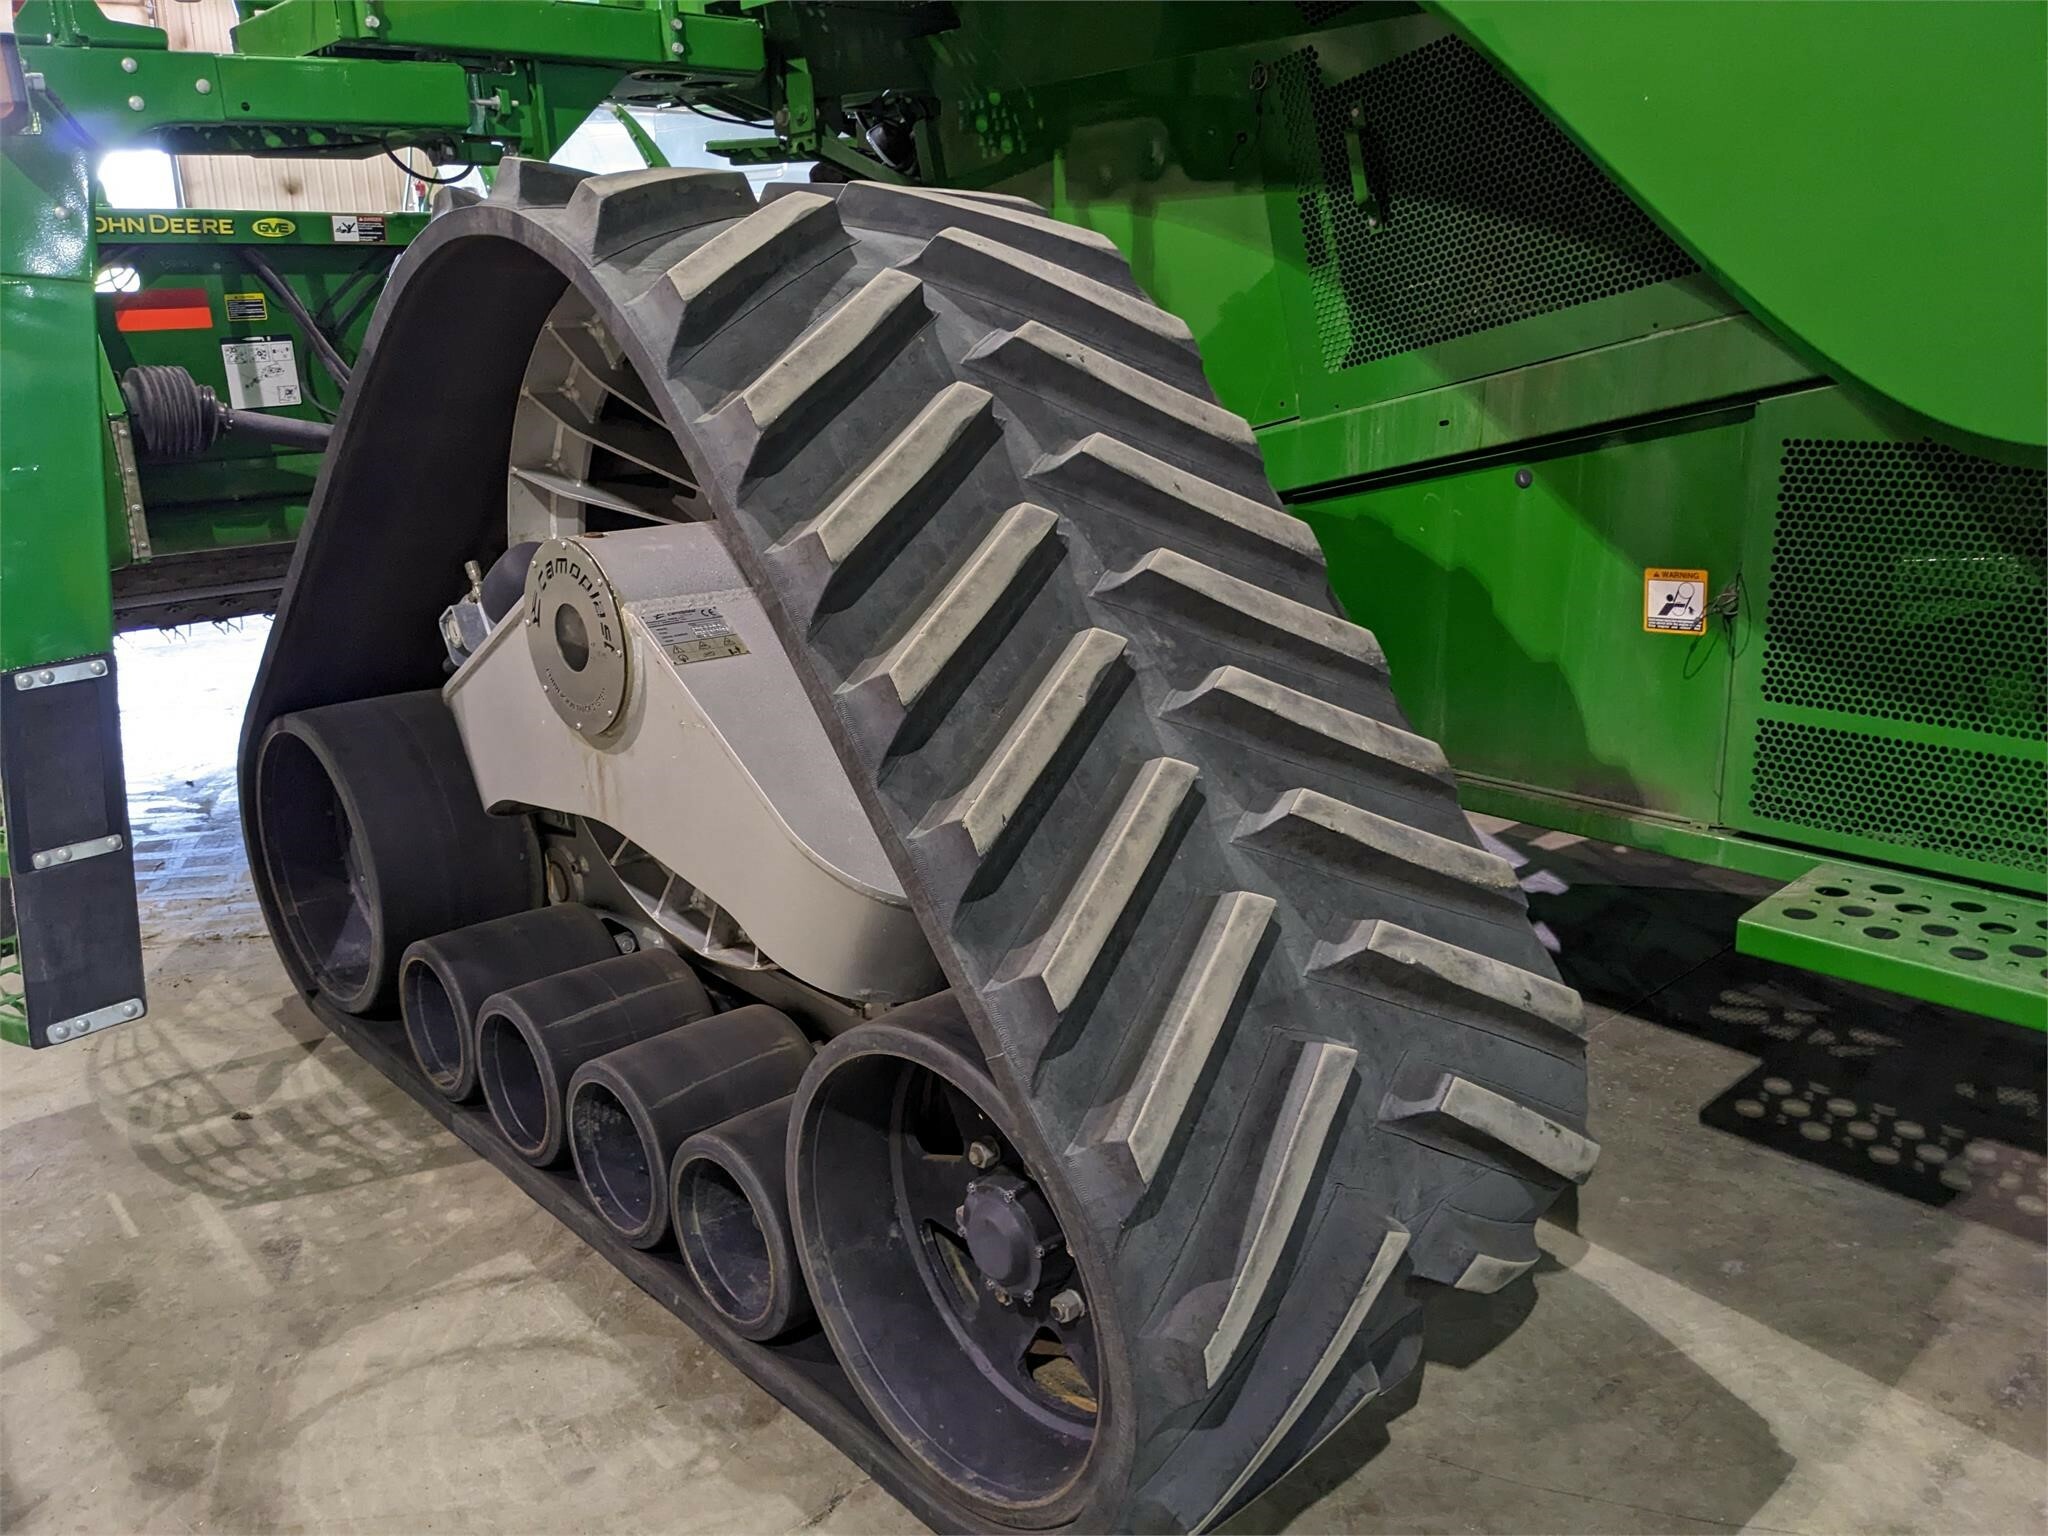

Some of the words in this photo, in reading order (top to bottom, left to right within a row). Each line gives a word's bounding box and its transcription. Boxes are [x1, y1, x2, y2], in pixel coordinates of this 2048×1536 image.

[95, 216, 145, 234] OHN
[149, 214, 235, 235] DEERE
[257, 222, 290, 235] GVE
[1661, 571, 1700, 580] WARNING
